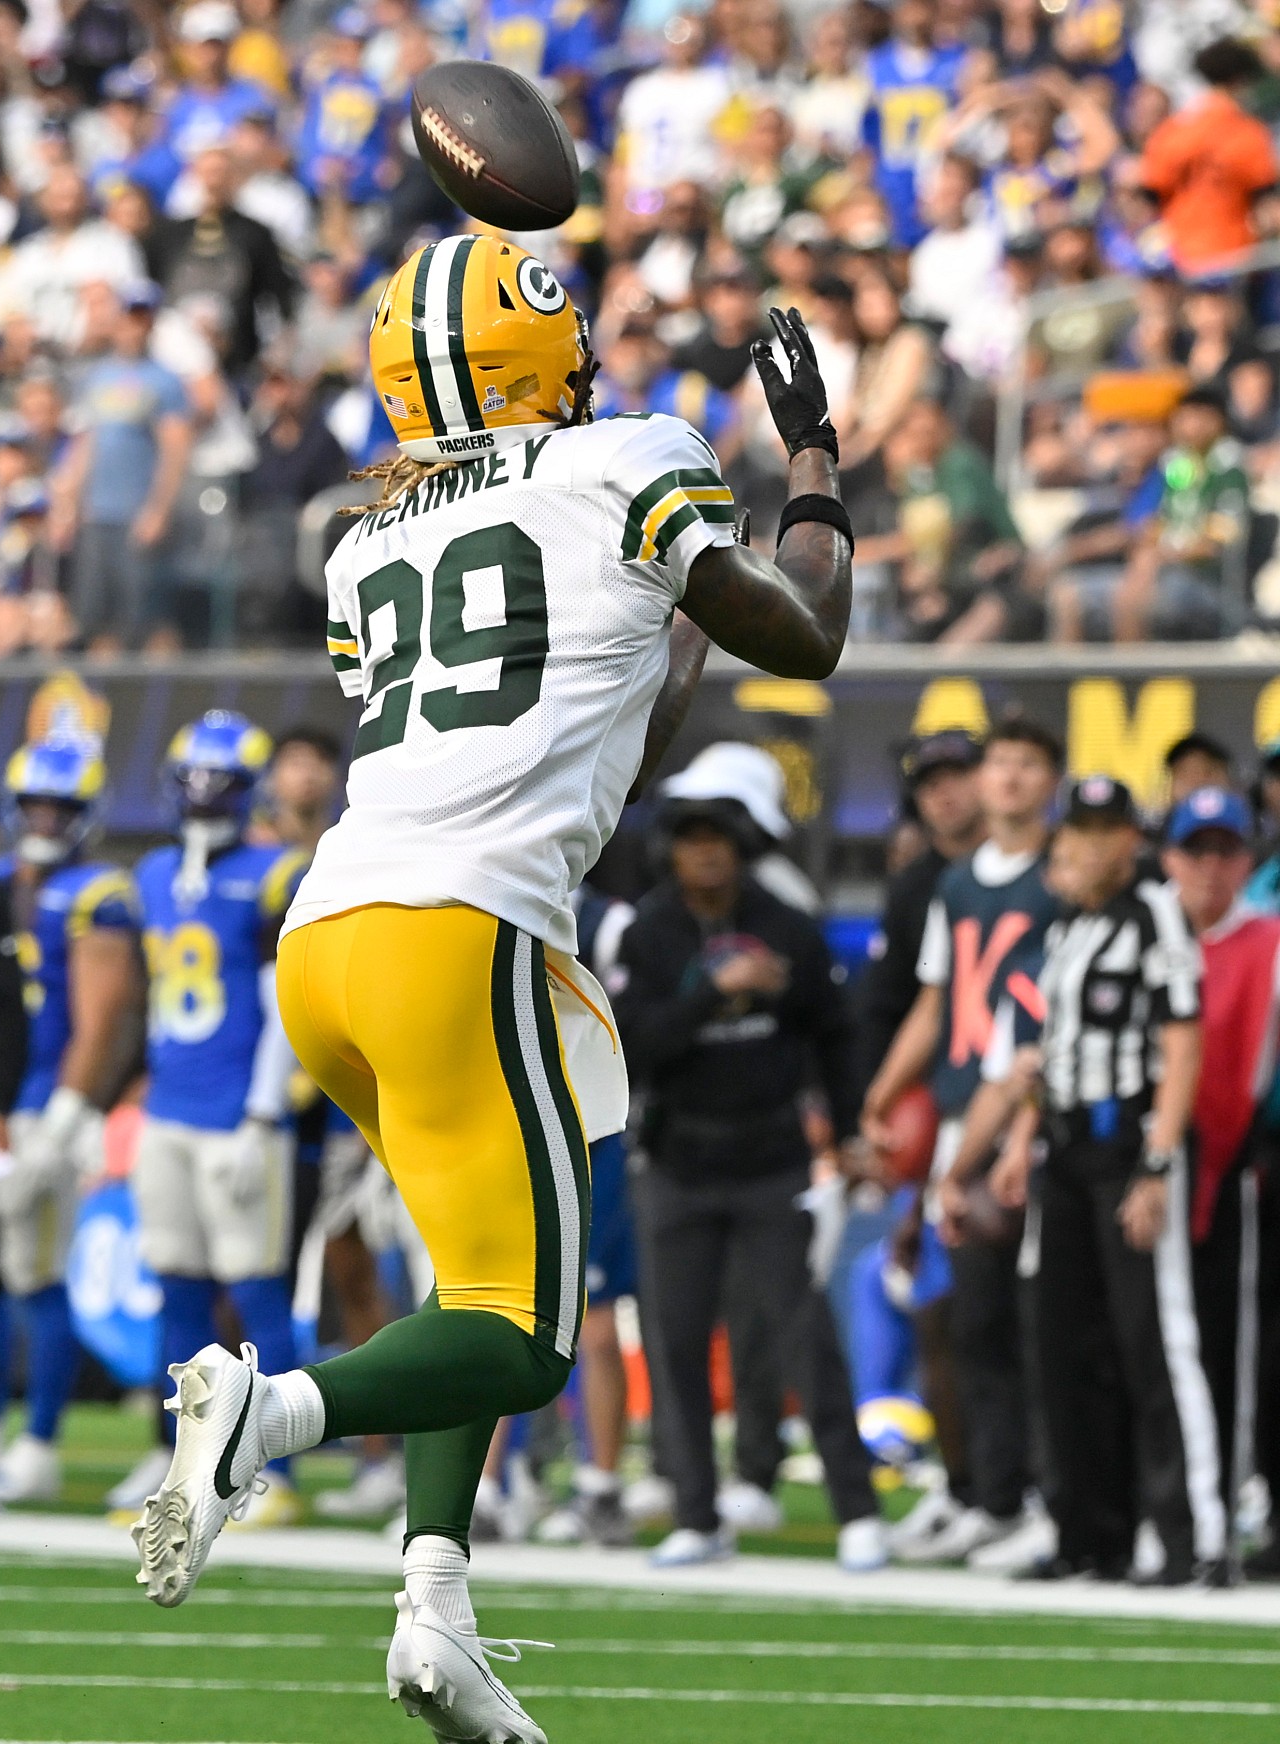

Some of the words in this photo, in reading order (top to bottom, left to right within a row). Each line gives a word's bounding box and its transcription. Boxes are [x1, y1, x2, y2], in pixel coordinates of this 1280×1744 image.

[483, 397, 505, 410] CATCH
[436, 433, 495, 454] PACKERS
[351, 521, 549, 764] 29
